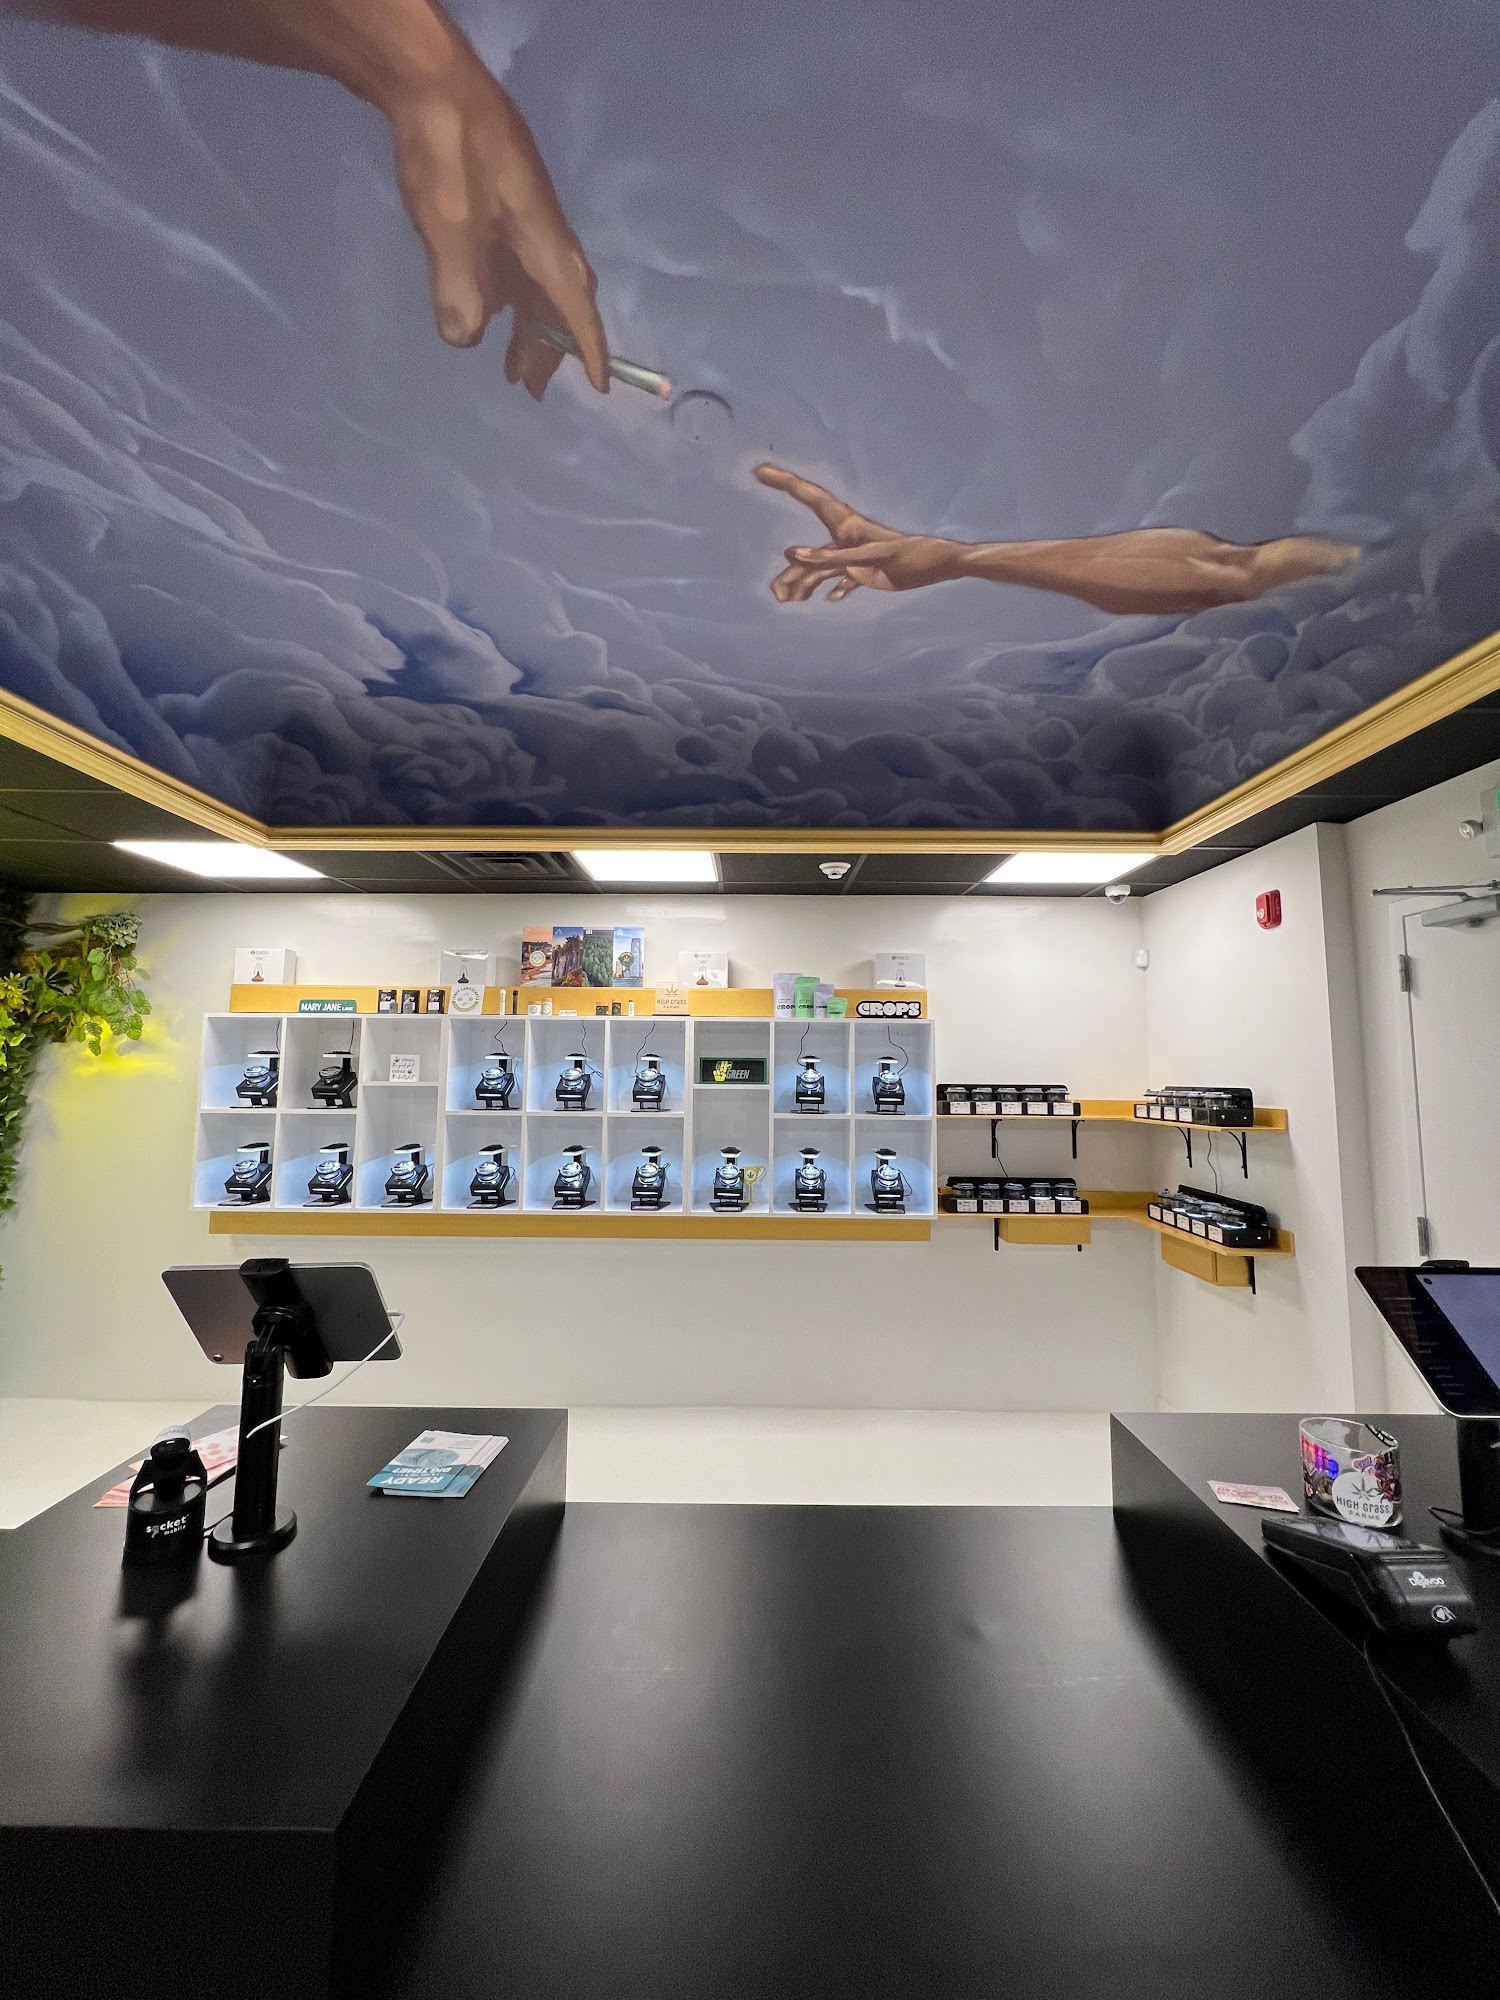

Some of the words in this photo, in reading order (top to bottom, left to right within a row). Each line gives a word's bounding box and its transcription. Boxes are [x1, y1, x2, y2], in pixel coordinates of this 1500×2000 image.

[301, 1003, 322, 1011] MARY
[322, 1003, 342, 1011] JANE
[858, 1002, 920, 1016] CROPS
[726, 1069, 750, 1080] GREEN
[380, 1476, 444, 1485] READY
[1336, 1495, 1360, 1510] HIGH
[1362, 1502, 1391, 1514] Grass
[1349, 1509, 1380, 1520] FARMS
